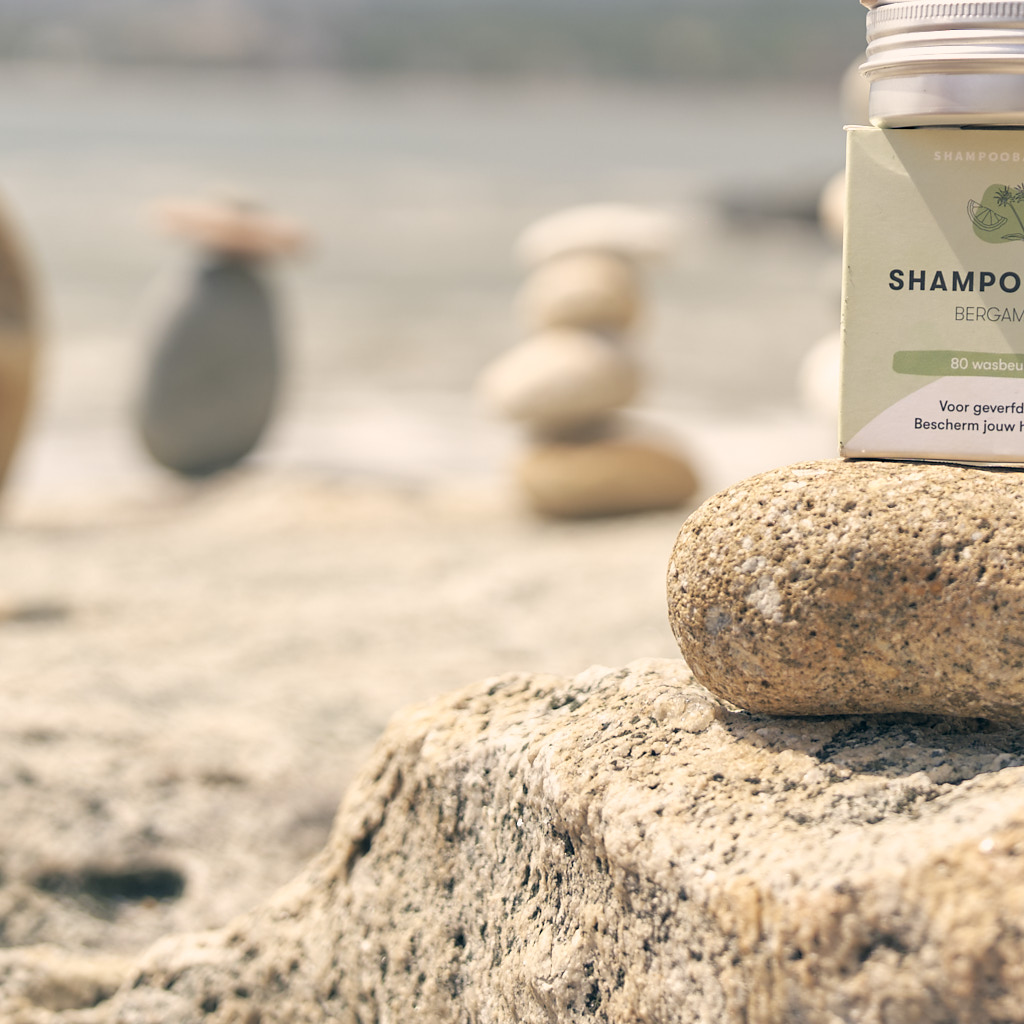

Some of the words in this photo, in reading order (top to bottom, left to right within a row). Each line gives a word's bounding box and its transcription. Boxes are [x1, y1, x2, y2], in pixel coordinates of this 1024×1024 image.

[950, 357, 969, 370] 80
[939, 400, 969, 413] Voor
[973, 401, 1024, 416] geverfd
[914, 418, 979, 431] Bescherm
[982, 420, 1015, 434] jouw
